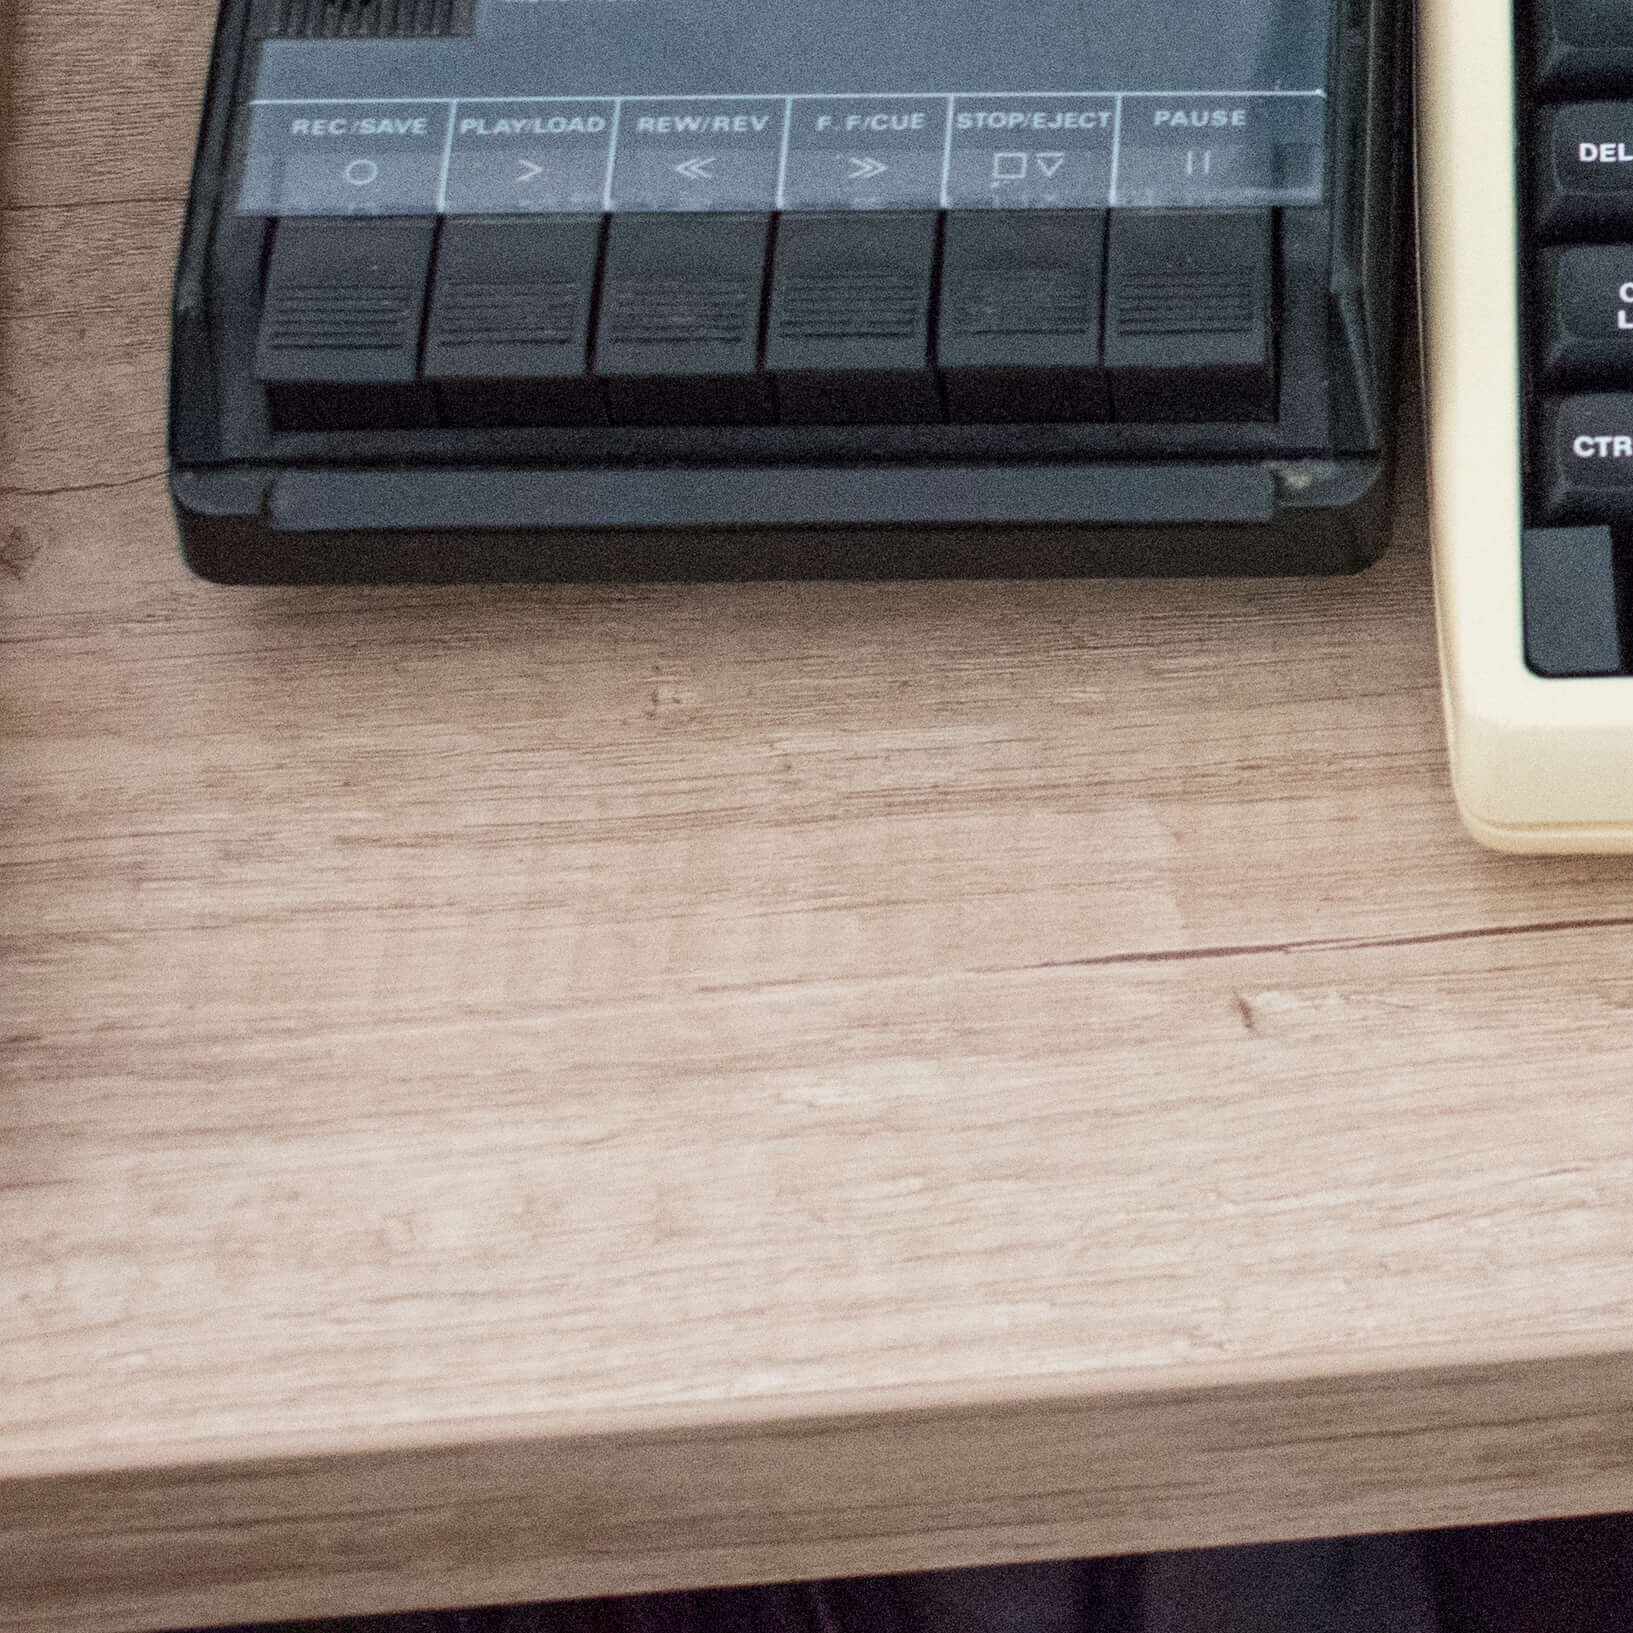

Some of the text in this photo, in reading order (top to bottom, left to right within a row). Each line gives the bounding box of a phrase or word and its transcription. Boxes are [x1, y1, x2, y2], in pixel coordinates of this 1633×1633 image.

[292, 118, 426, 136] REC/SAVE
[460, 115, 607, 135] PLAY/LOAD
[637, 115, 768, 133] REW/REV
[956, 110, 1113, 130] STOP/EJECT
[1154, 109, 1244, 127] PAUSE
